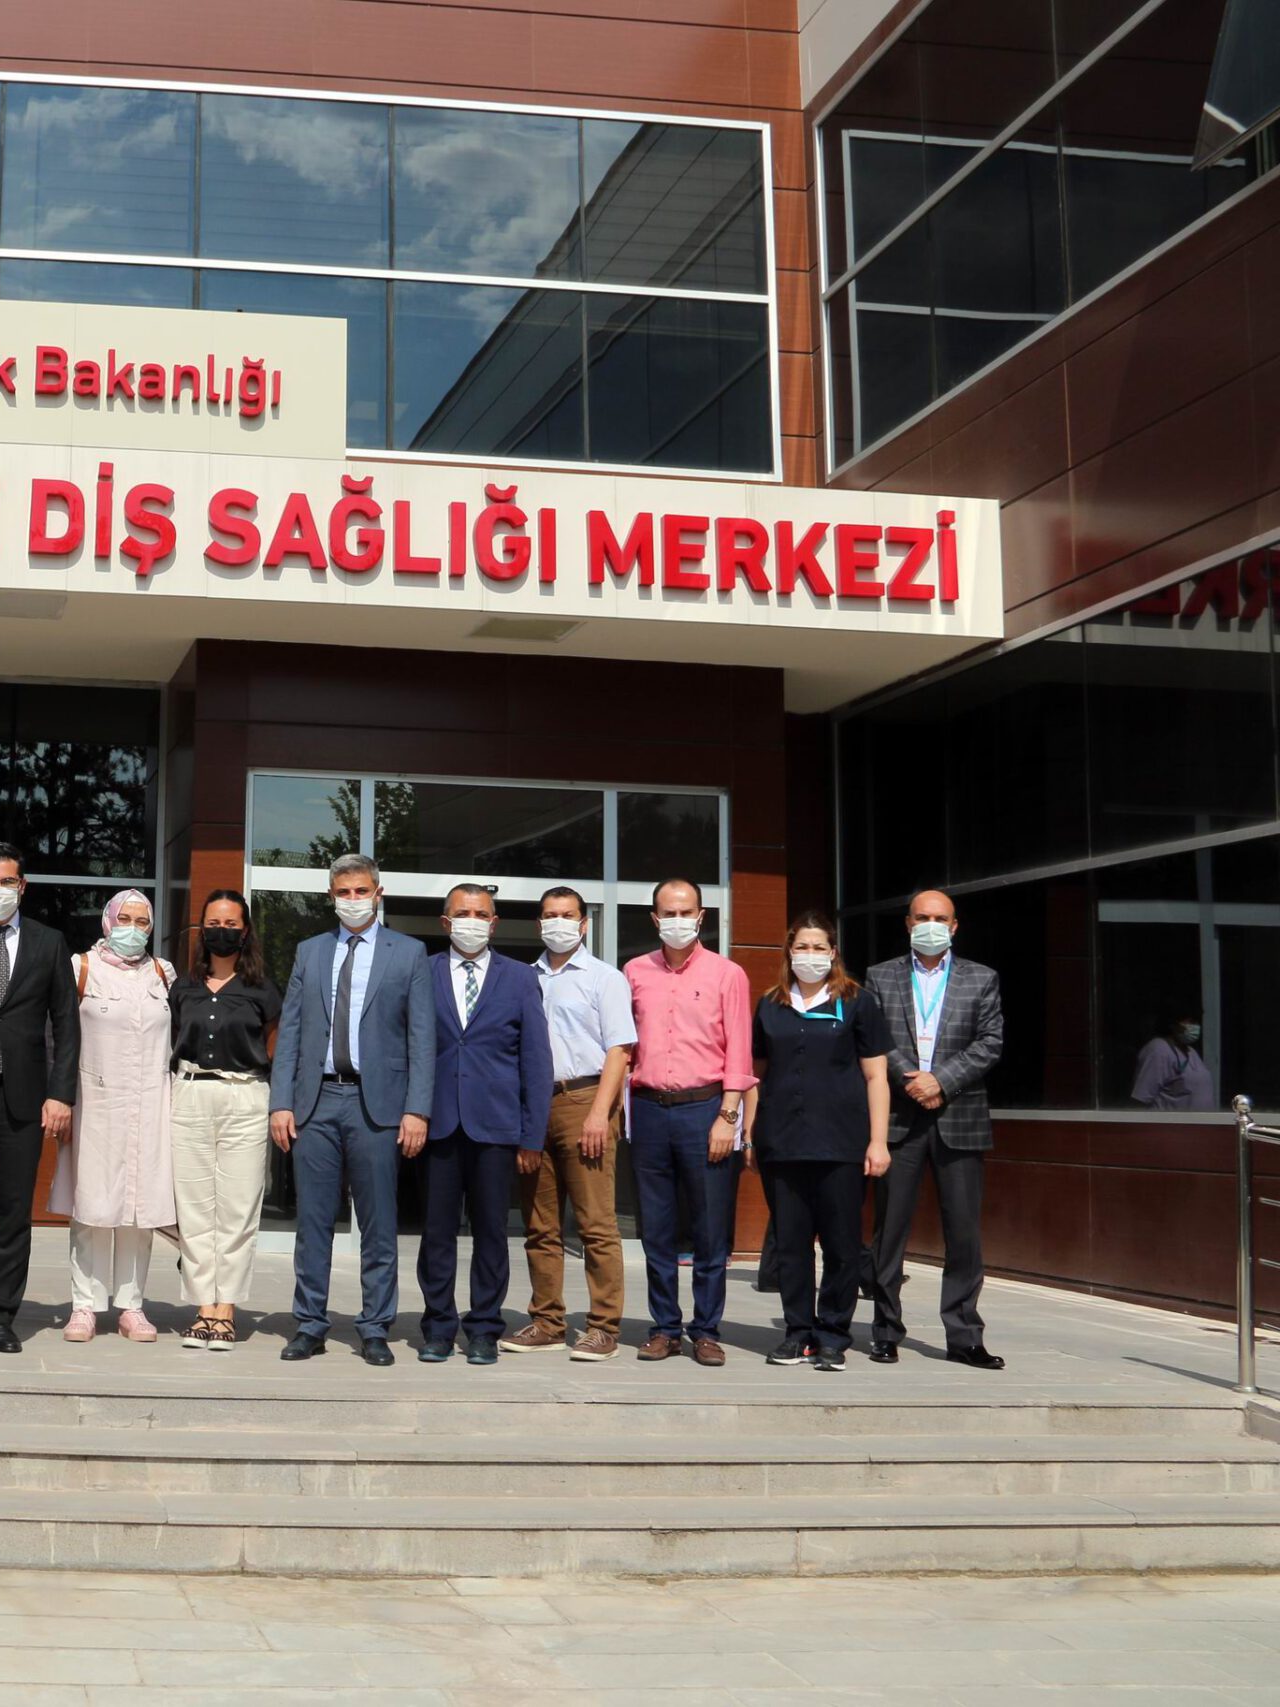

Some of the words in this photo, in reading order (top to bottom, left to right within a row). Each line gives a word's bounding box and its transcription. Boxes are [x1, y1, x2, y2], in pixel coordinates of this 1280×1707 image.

[34, 345, 282, 418] Bakanlığı
[28, 461, 177, 576] DİŞ
[205, 473, 557, 590] SAĞLIĞI
[587, 509, 960, 603] MERKEZİ
